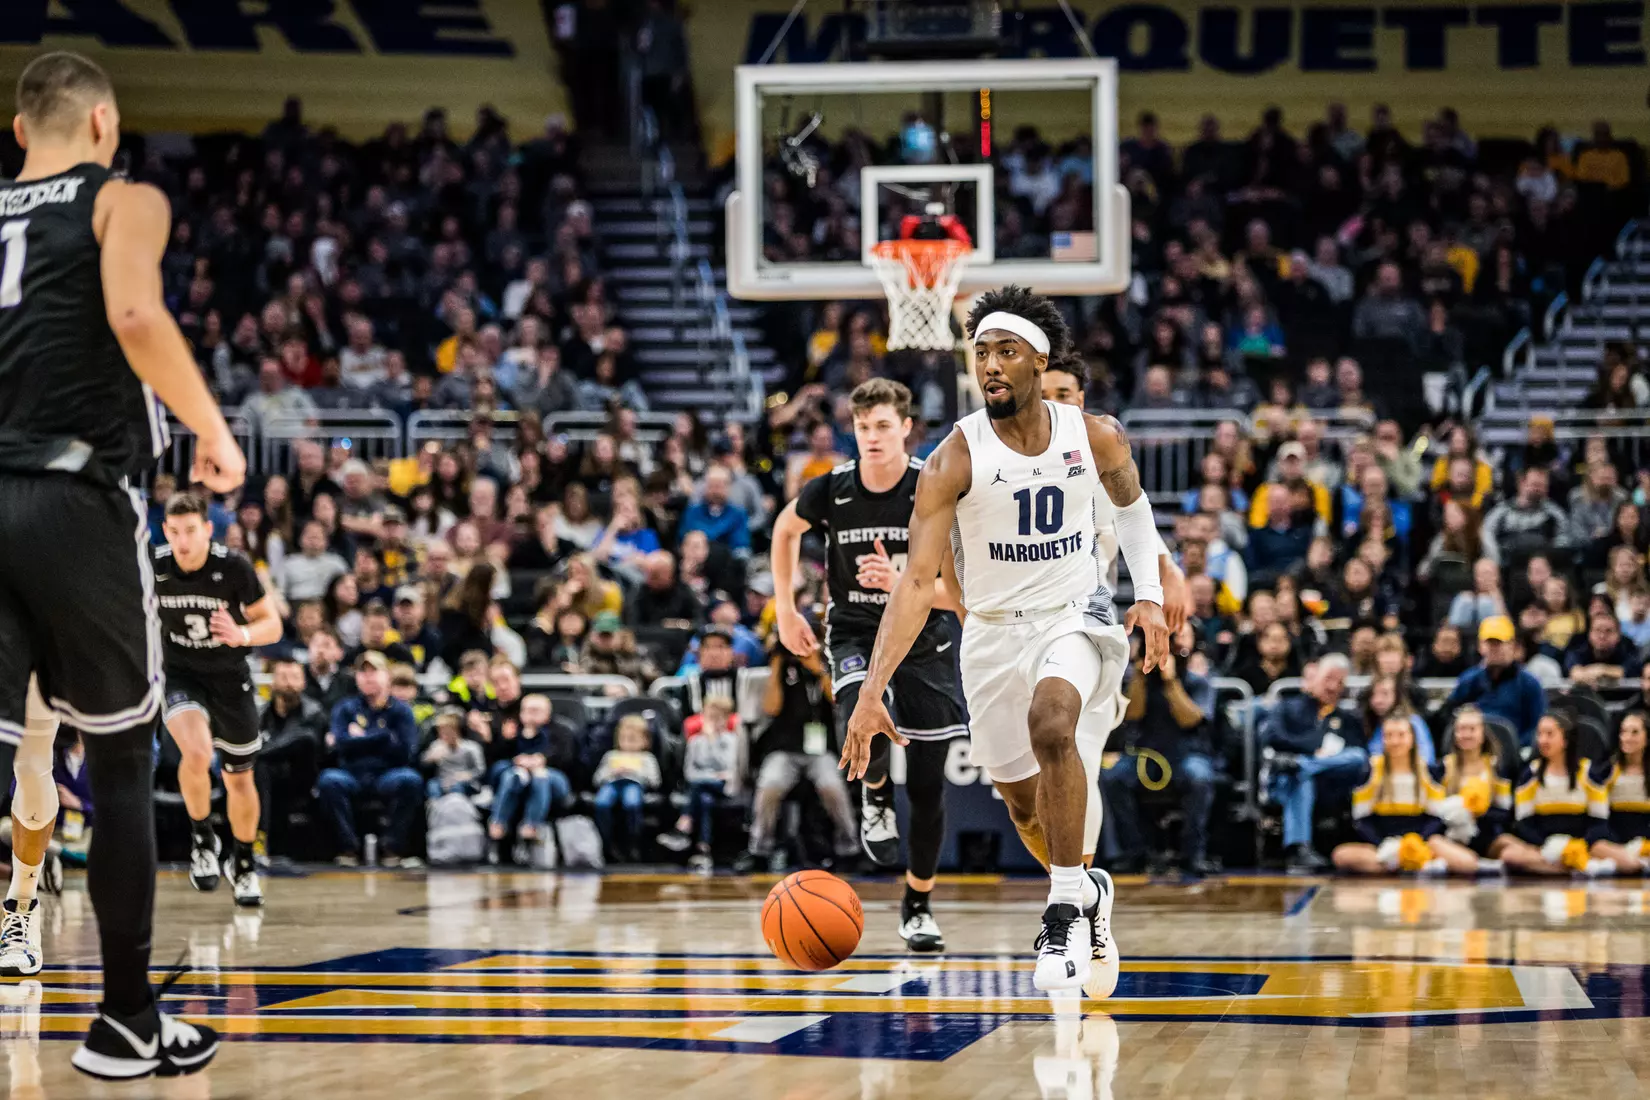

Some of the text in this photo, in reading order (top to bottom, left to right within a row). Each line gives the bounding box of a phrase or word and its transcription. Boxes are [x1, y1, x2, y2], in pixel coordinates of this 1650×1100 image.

[745, 1, 1647, 73] MRQUETTE
[0, 218, 31, 309] 1
[1032, 468, 1042, 476] AL
[1013, 485, 1065, 536] 10
[837, 526, 909, 545] CENTRA
[988, 531, 1082, 562] MARQUETTE
[184, 613, 209, 641] 3
